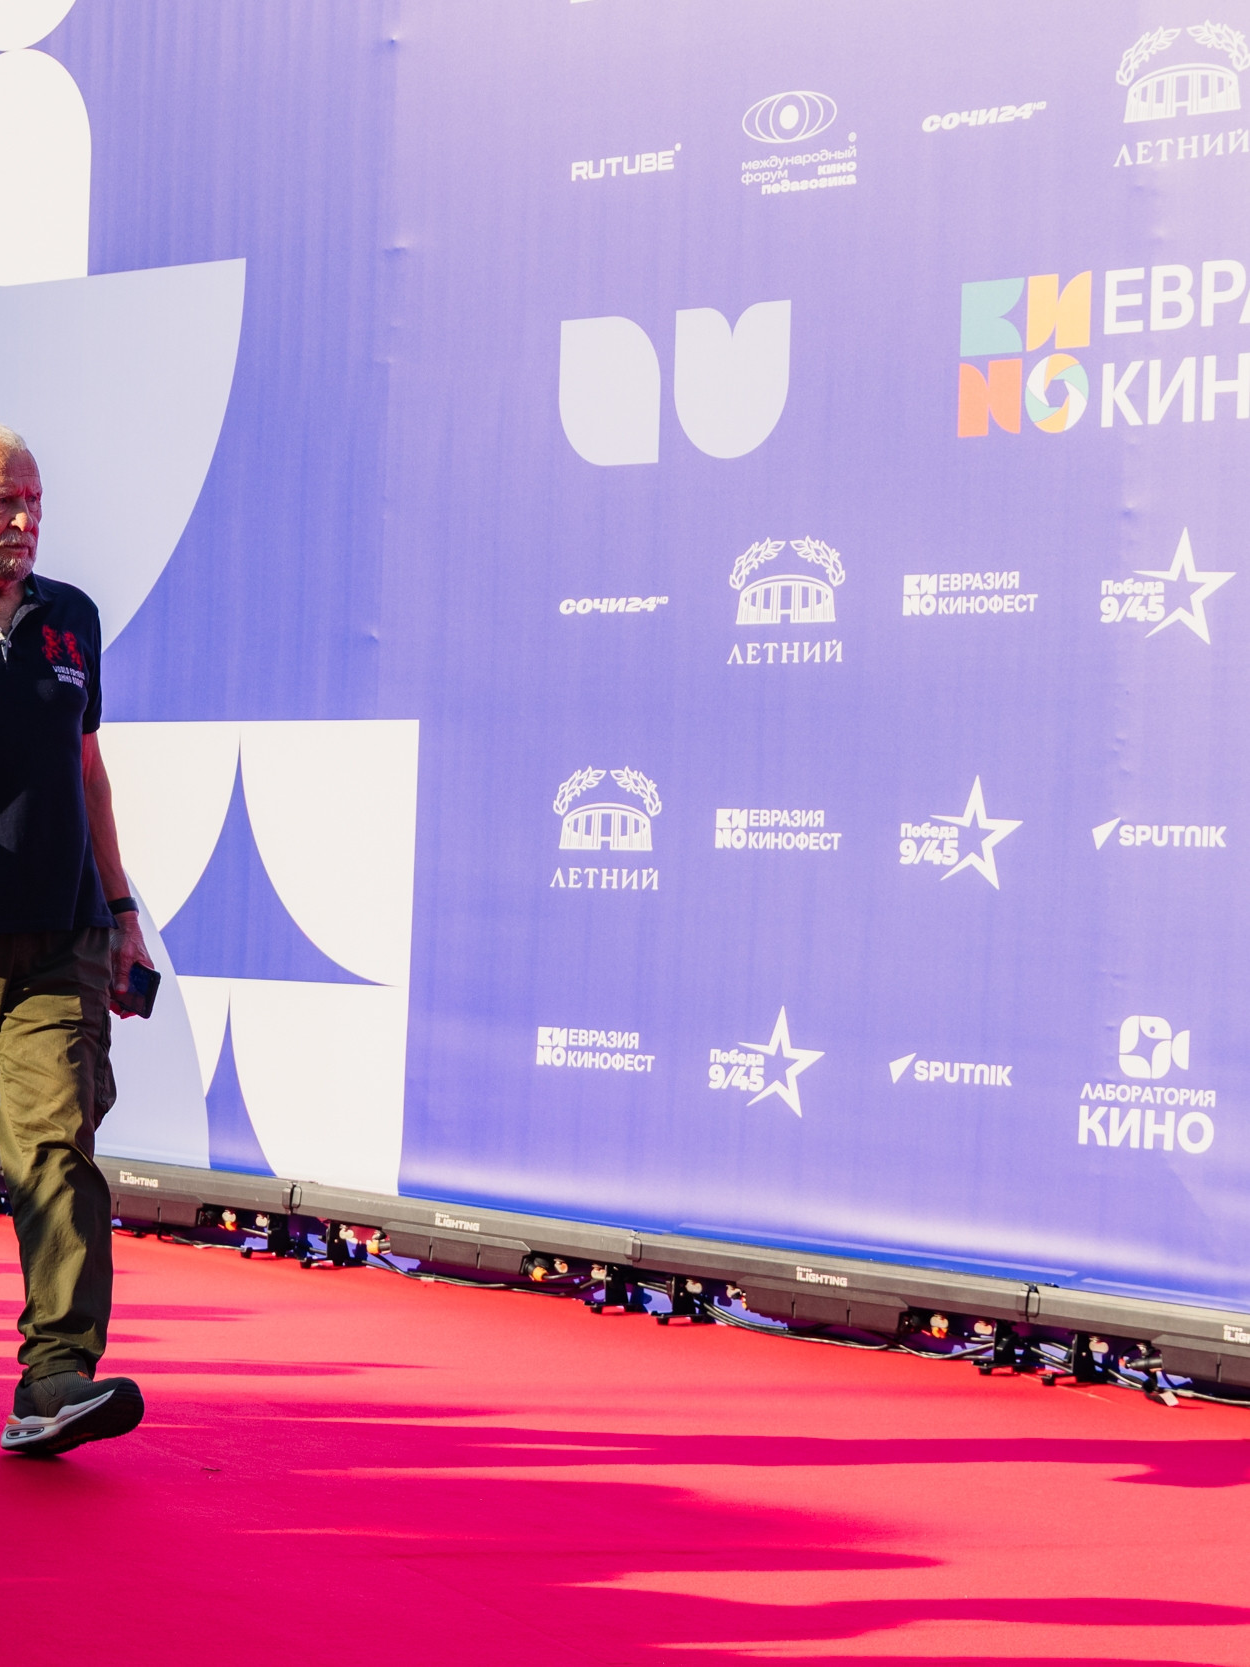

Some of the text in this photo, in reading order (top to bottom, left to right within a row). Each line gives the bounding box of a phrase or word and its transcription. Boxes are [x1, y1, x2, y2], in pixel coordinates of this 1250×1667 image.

[741, 144, 857, 171] международный
[1113, 128, 1250, 168] ЛЕТНИЙ
[571, 150, 675, 182] RUTUBE
[741, 161, 857, 186] форум кино
[1103, 259, 1250, 335] ЕВР
[938, 571, 1020, 592] ЕВРАЗИЯ
[1101, 577, 1165, 596] Победа
[937, 593, 1039, 615] КИНОФЕСТ
[1099, 595, 1166, 624] 9/45
[727, 640, 843, 665] ЛЕТНИЙ
[748, 809, 825, 828] ЕВРАЗИЯ
[900, 821, 959, 840] Победа
[748, 831, 842, 851] КИНОФЕСТ
[1118, 824, 1227, 848] SPUTNIK
[899, 838, 960, 866] 9/45
[550, 867, 659, 891] ЛЕТНИЙ
[568, 1028, 640, 1050] ЕВРАЗИЯ
[567, 1050, 656, 1073] КИНОФЕСТ
[710, 1048, 765, 1067] Победа
[708, 1063, 765, 1092] 9/45
[913, 1060, 1013, 1087] SPUTNIK
[1080, 1082, 1217, 1108] ЛАБОРАТОРИЯ
[1077, 1104, 1215, 1155] КИНО
